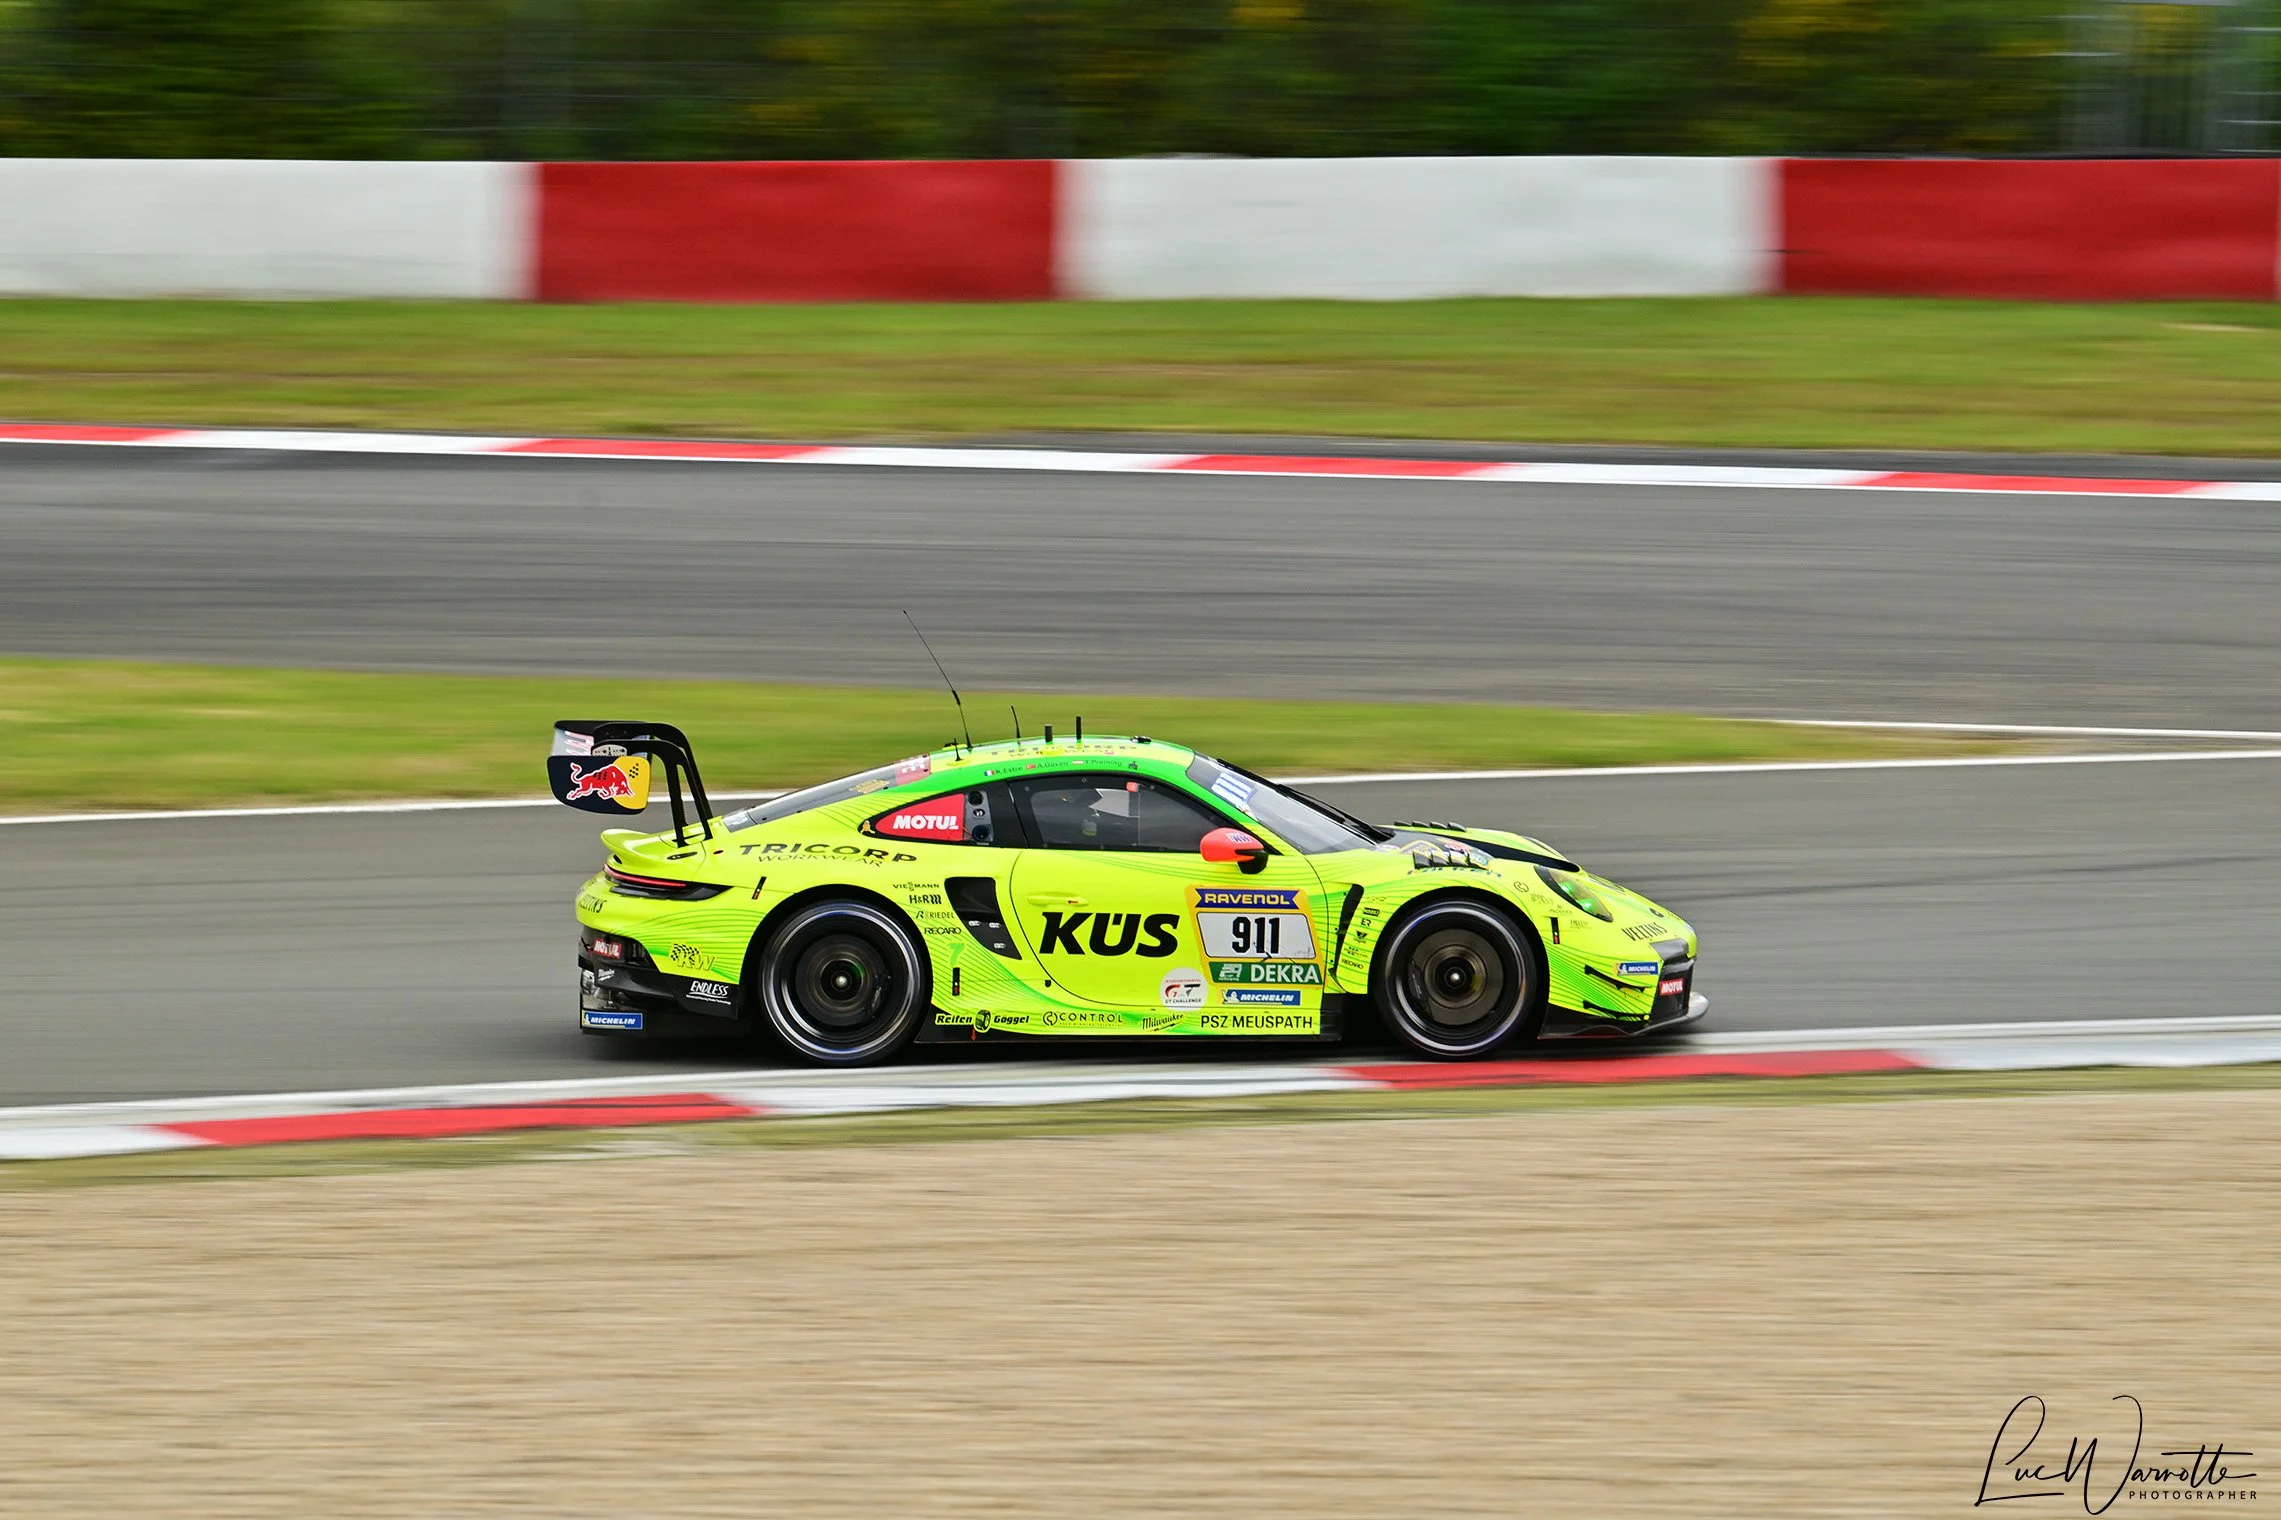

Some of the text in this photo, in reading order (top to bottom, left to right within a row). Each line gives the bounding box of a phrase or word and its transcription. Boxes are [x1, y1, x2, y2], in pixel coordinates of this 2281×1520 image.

[893, 815, 959, 831] MOTUL
[739, 843, 918, 863] TRICORP
[758, 854, 883, 868] WORKWEAR
[1204, 892, 1290, 905] RAVENOL
[929, 911, 955, 919] RIEDEL
[924, 927, 962, 935] RECARO
[1039, 912, 1180, 958] KÜS
[1231, 916, 1280, 954] 911
[1621, 922, 1668, 942] VELTINS
[1250, 964, 1320, 984] DEKRA
[1628, 965, 1656, 973] MICHELIN
[690, 980, 729, 997] ENDLESS
[1661, 981, 1684, 993] MOTUL
[1240, 993, 1294, 1002] MICHELIN
[590, 1016, 636, 1025] MICHELIN
[936, 1013, 973, 1024] Reifen
[1059, 1012, 1124, 1023] CONTROL
[1142, 1013, 1184, 1030] Milwaukee
[1201, 1015, 1312, 1029] PSZ MEUSPATH
